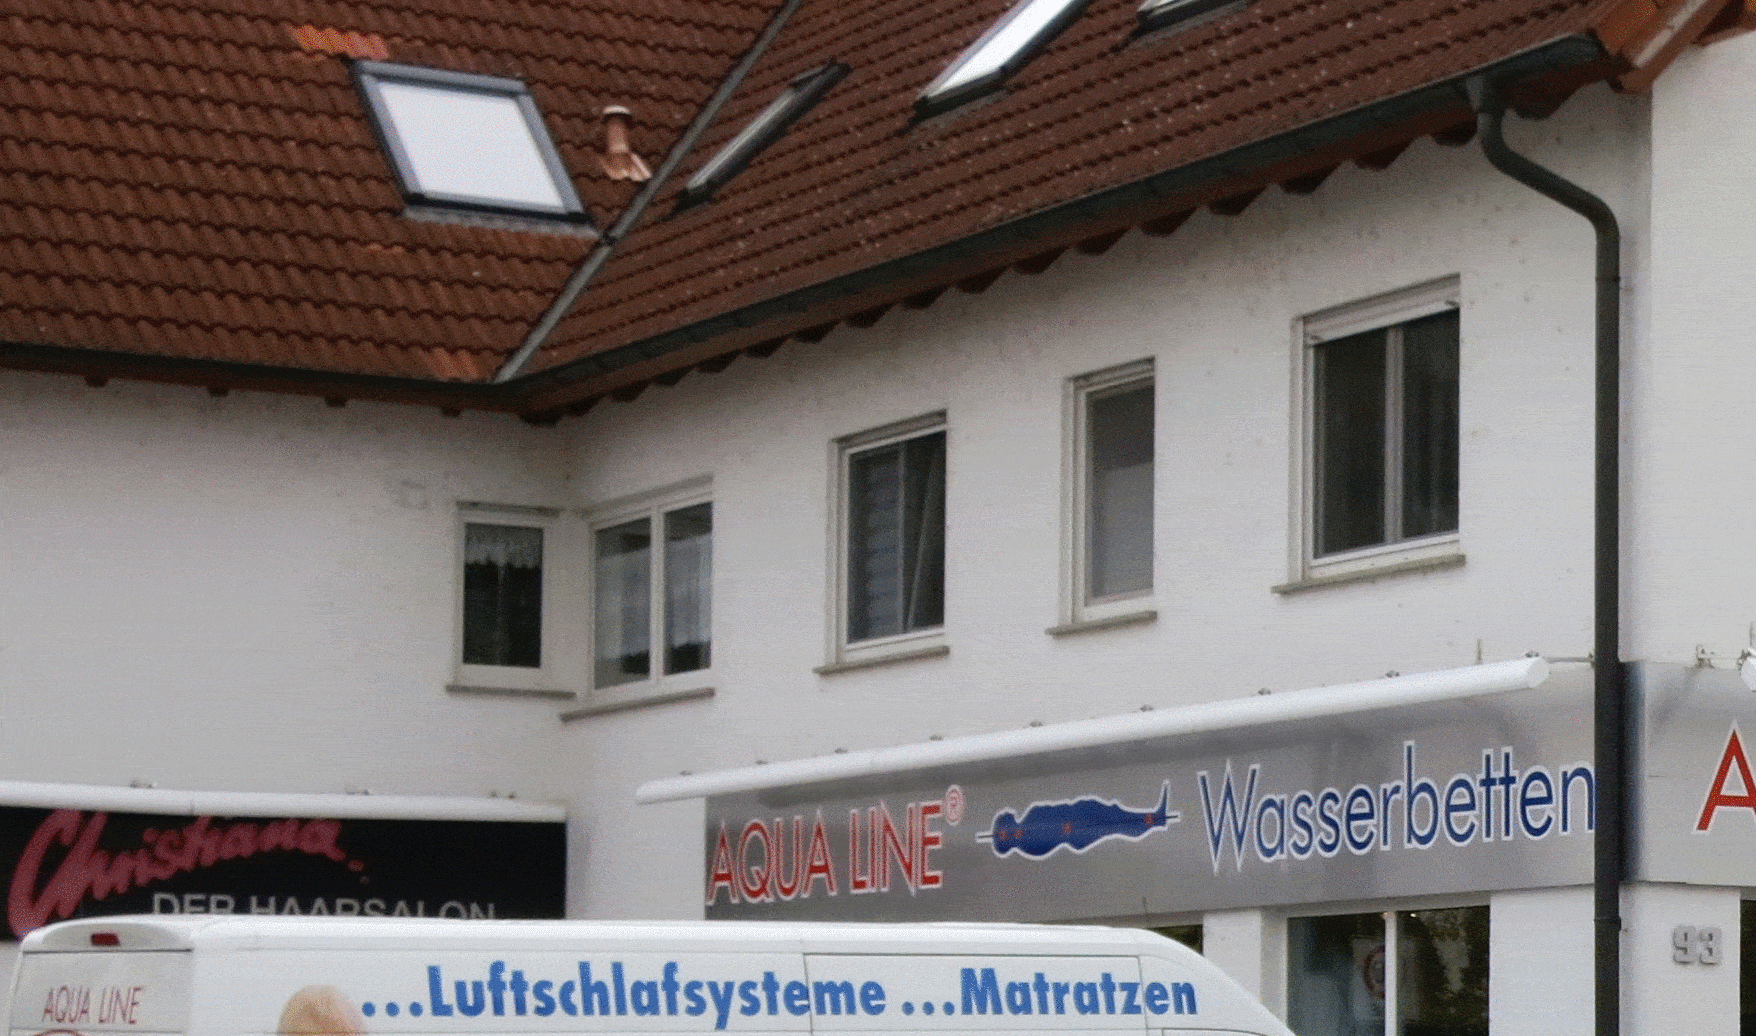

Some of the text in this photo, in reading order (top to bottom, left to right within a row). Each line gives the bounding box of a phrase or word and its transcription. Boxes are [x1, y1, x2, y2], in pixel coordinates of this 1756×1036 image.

[1197, 740, 1596, 876] Wasserbetten
[705, 809, 839, 906] AQUA
[153, 892, 235, 915] DER
[1671, 924, 1723, 967] 93
[41, 985, 91, 1024] AQUA
